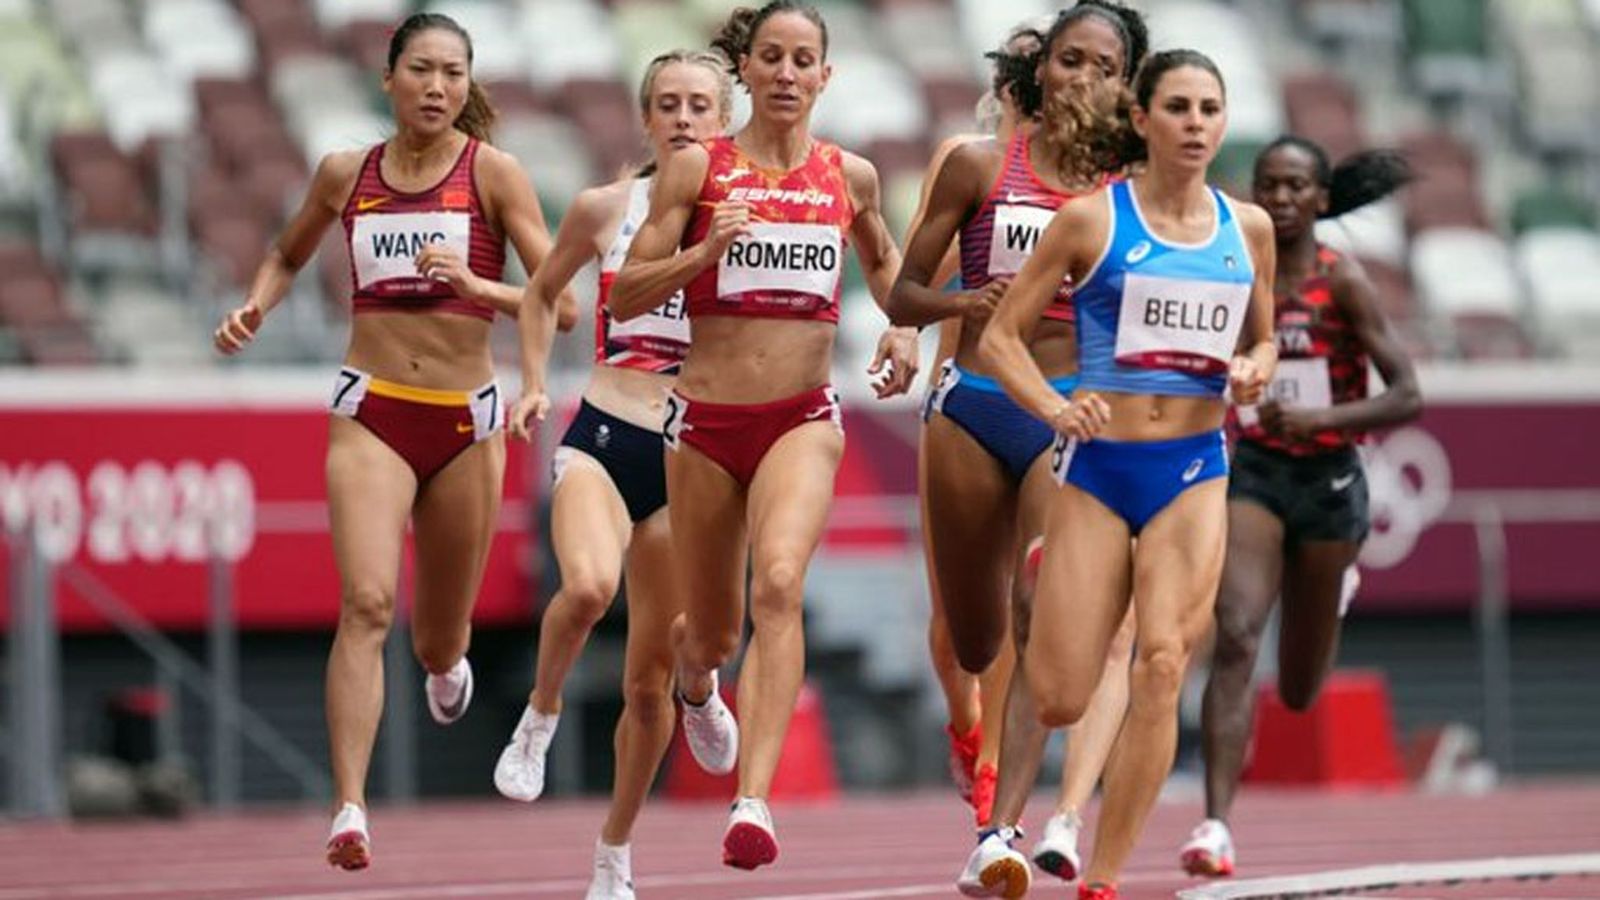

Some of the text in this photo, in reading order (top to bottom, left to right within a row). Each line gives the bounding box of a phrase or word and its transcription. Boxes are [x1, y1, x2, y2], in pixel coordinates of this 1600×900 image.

[726, 241, 836, 271] ROMERO
[1144, 298, 1229, 332] BELLO
[333, 370, 361, 408] 7
[477, 384, 497, 430] 7
[88, 460, 255, 562] 2020
